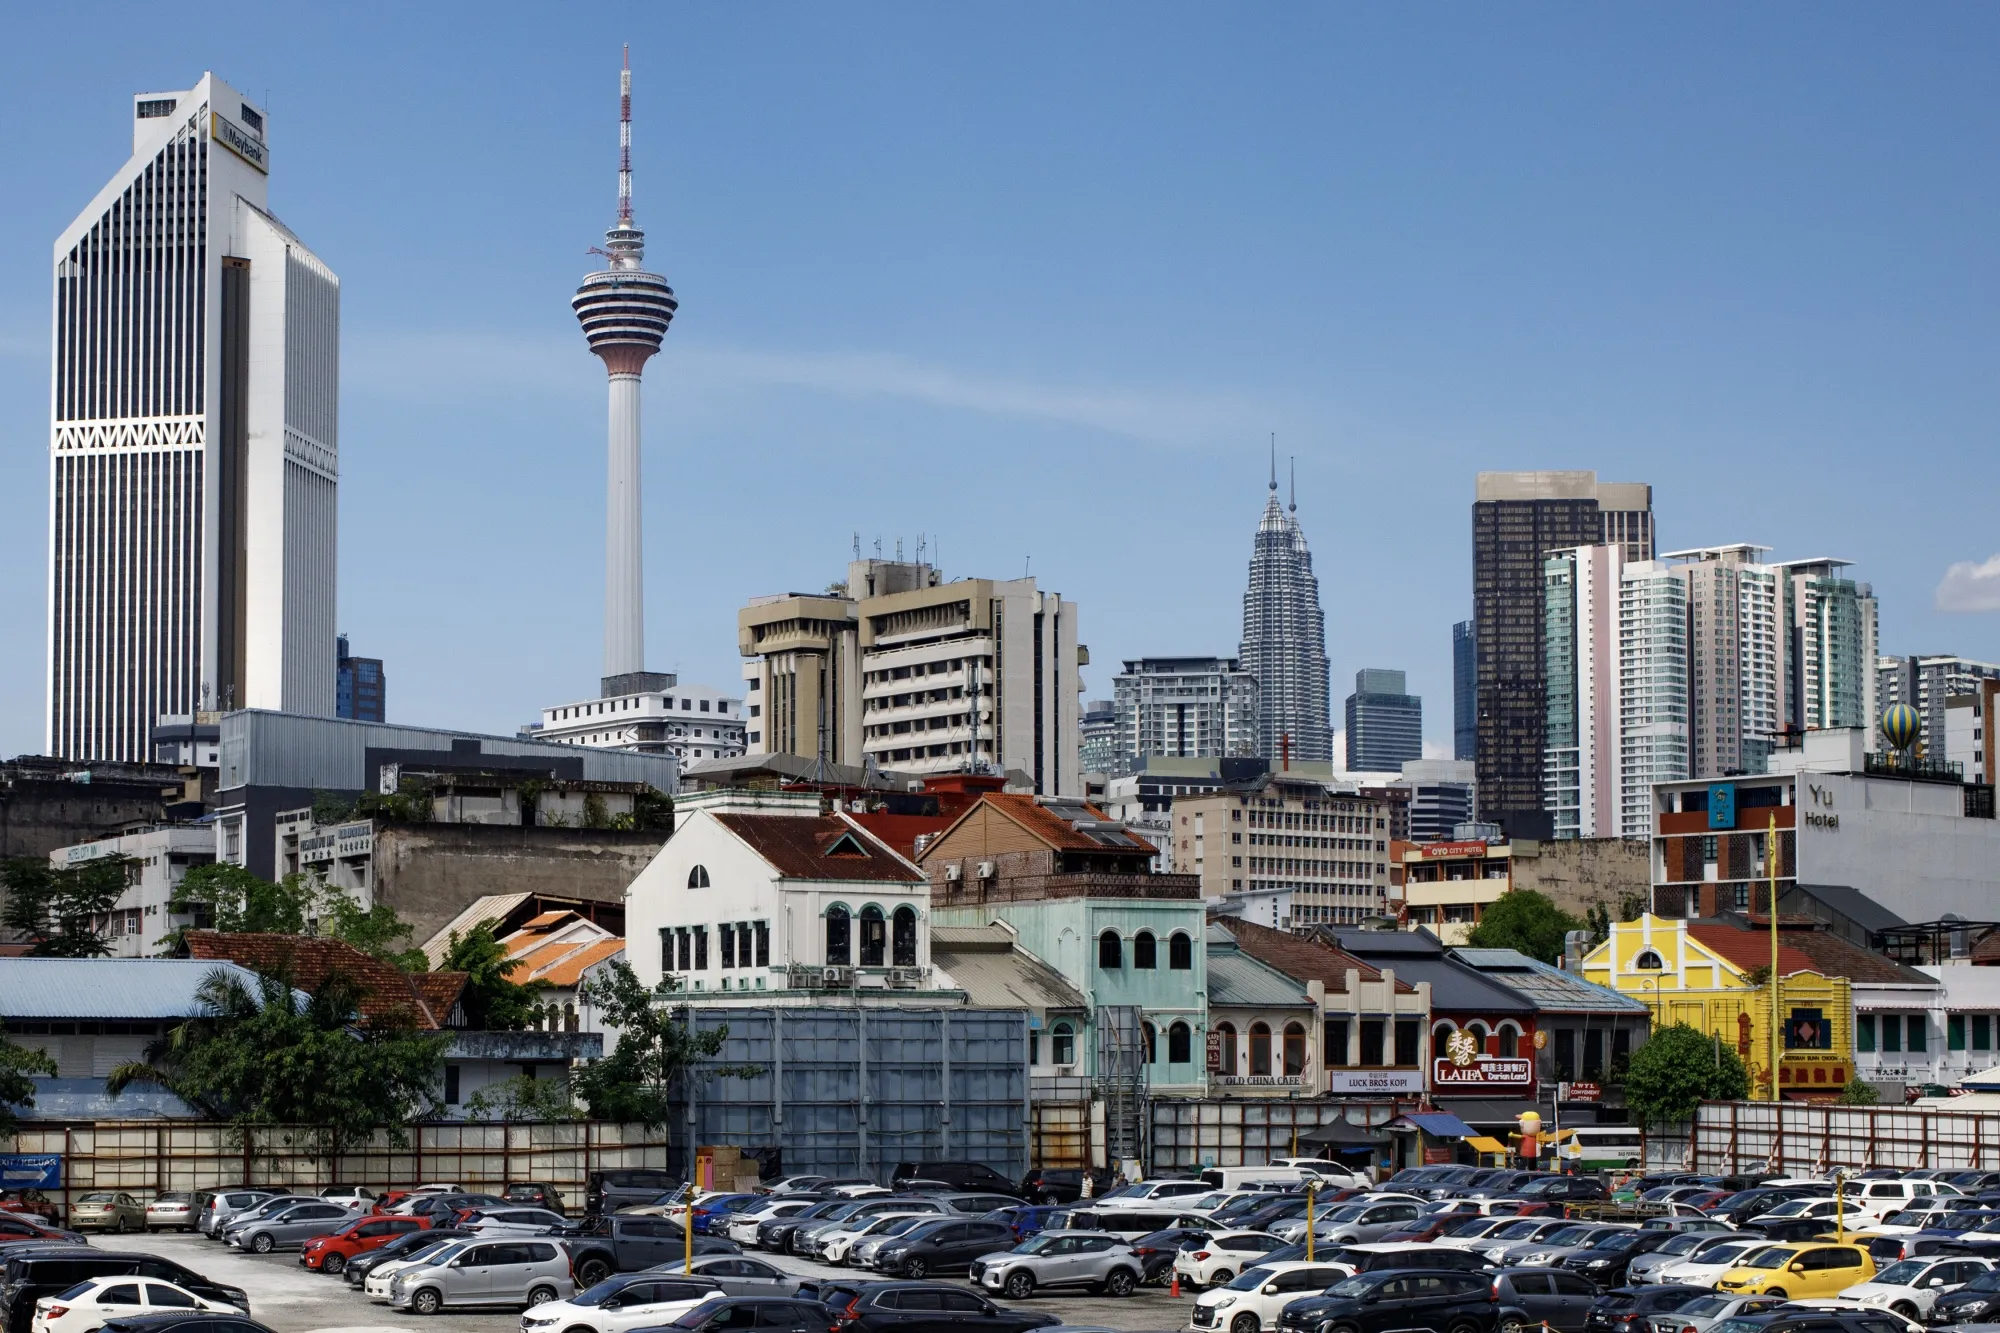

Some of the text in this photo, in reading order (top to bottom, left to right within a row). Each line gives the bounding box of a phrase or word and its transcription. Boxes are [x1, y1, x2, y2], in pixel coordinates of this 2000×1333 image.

[229, 128, 262, 164] Maybank
[1809, 784, 1833, 806] Yu
[1240, 797, 1381, 814] WISMA METHODIST
[1805, 811, 1839, 828] Hotel
[68, 847, 79, 861] HOTEL
[80, 846, 89, 860] CITY
[1431, 847, 1448, 856] OYO
[1226, 1076, 1300, 1085] OLD CHINA CAFE
[1440, 1069, 1484, 1081] LAIFA
[1488, 1072, 1527, 1080] Durian Land
[1349, 1079, 1408, 1087] LUCK BROS KOPI
[22, 1158, 57, 1166] KELUAR
